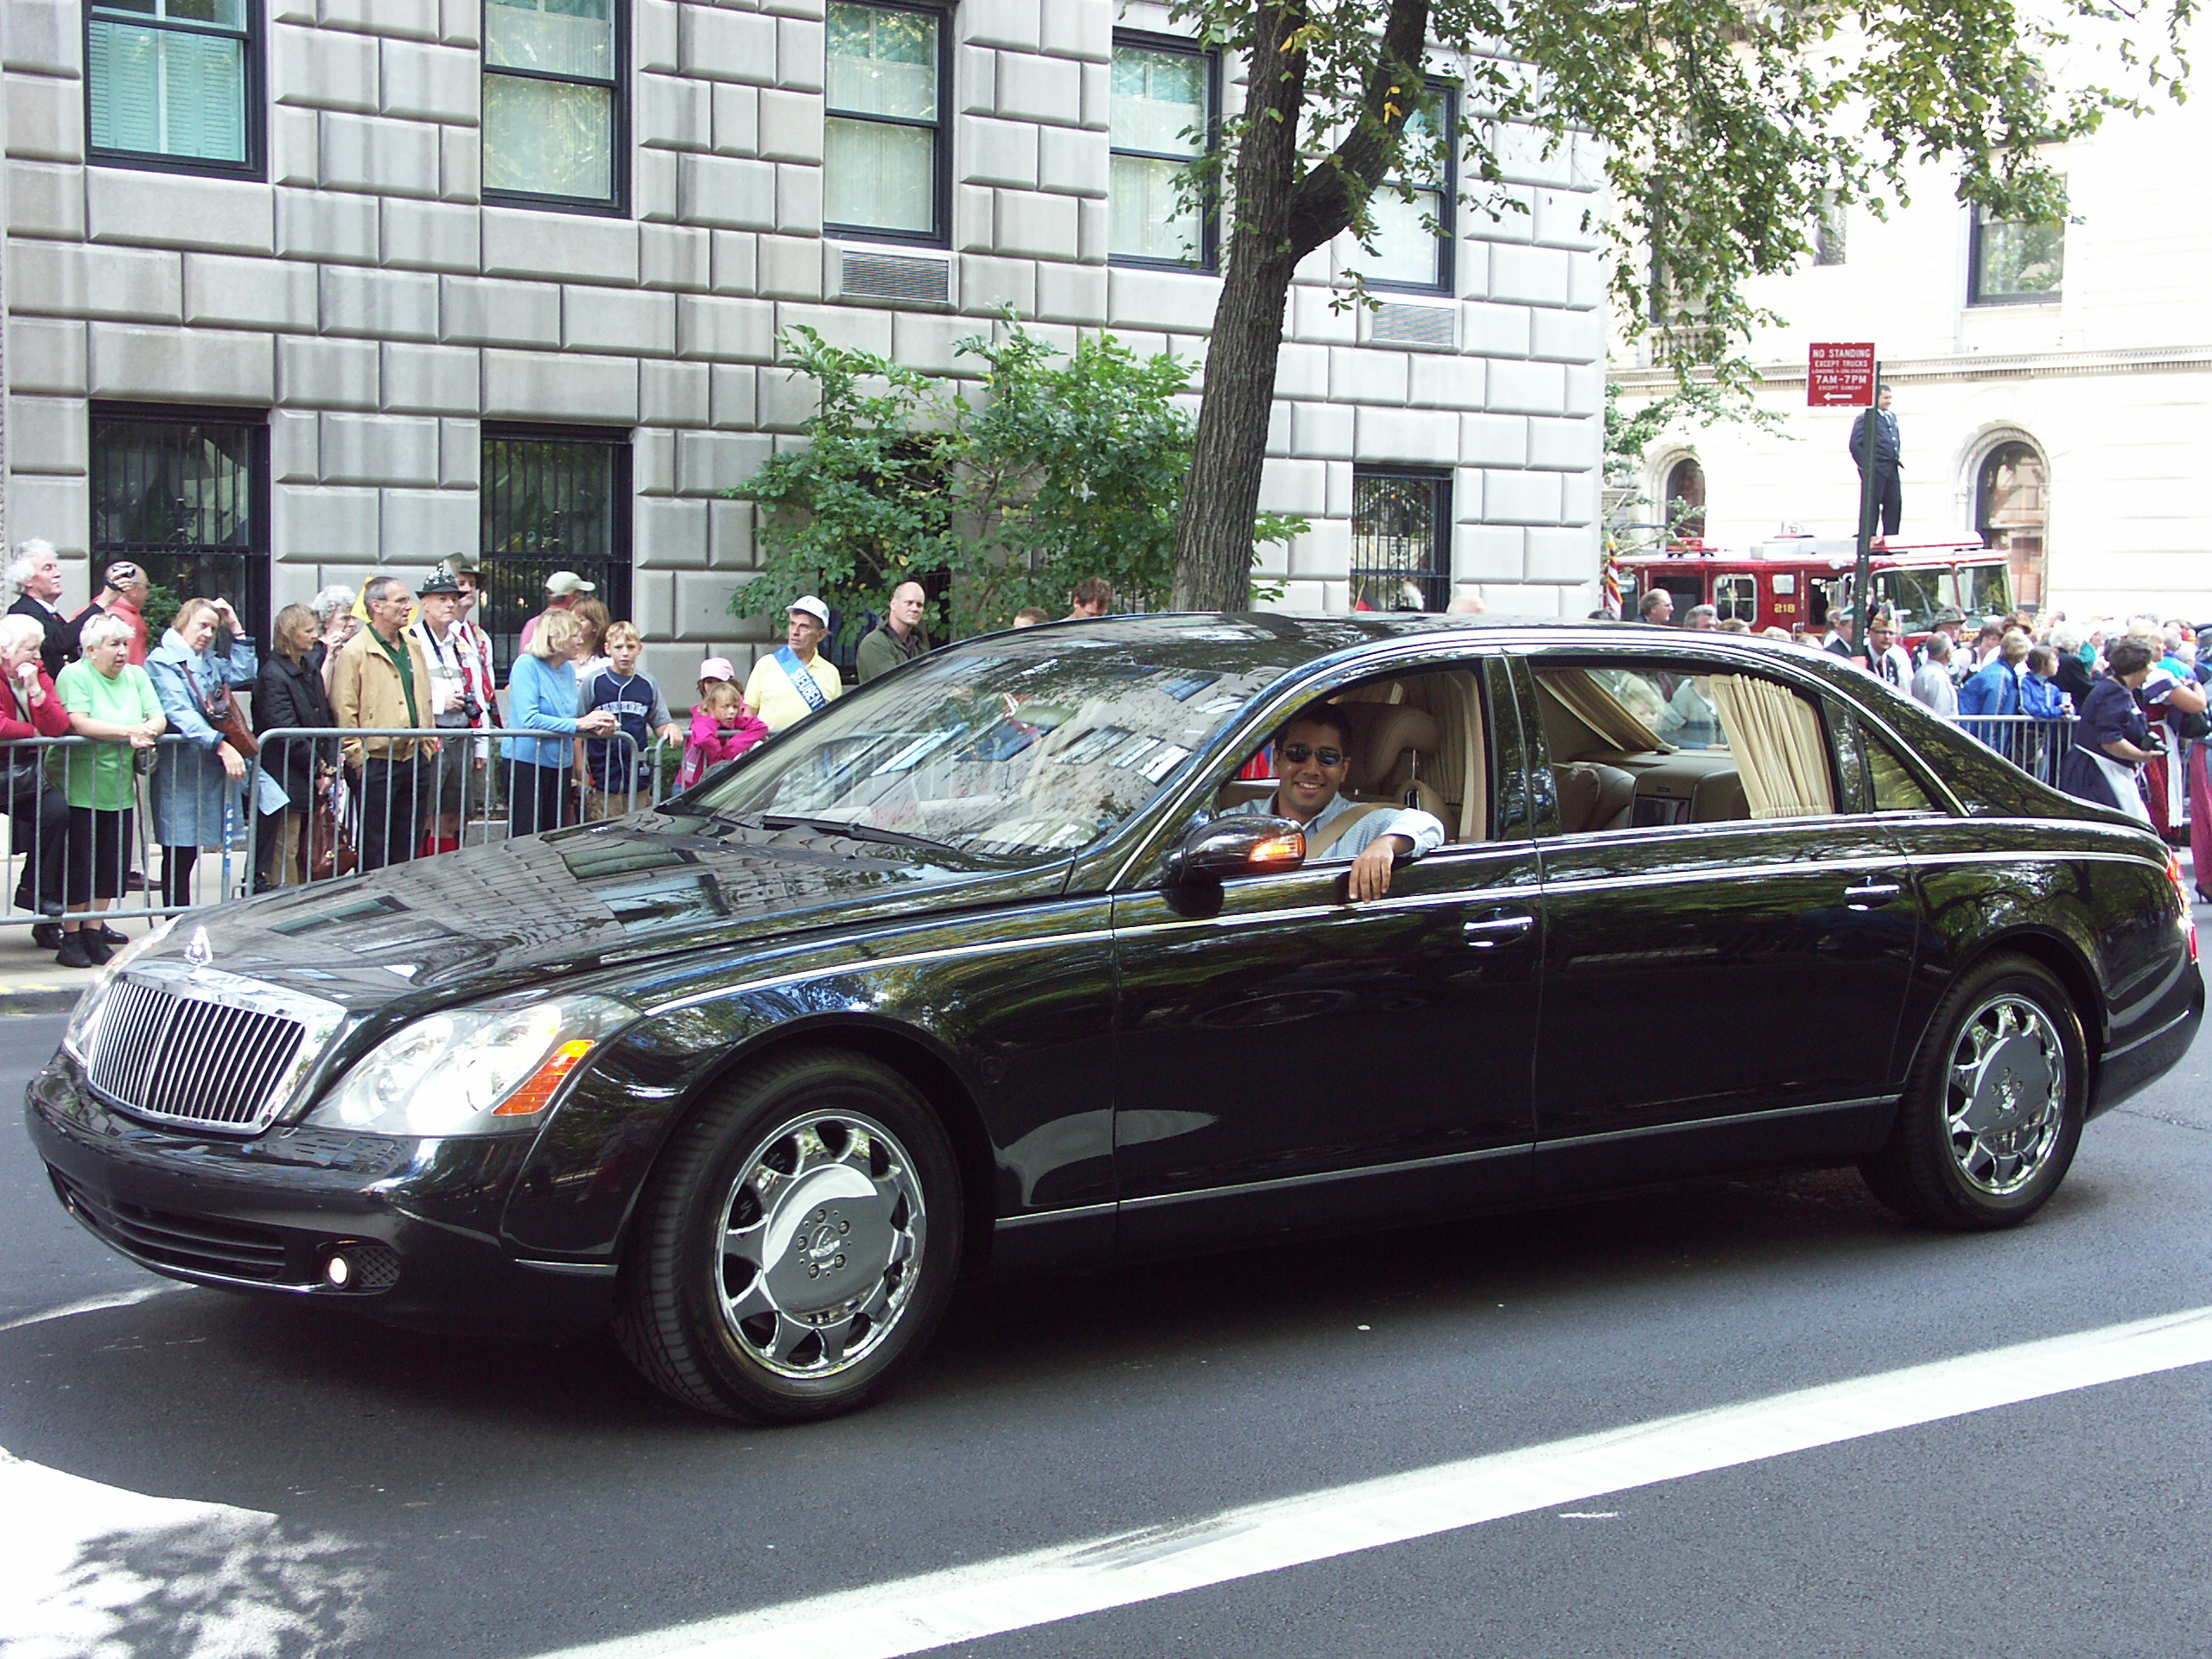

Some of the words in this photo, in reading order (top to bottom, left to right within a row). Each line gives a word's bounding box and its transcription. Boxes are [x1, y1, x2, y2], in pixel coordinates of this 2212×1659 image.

[1813, 349, 1825, 358] NO
[1828, 349, 1871, 358] STANDING
[1774, 603, 1796, 613] 218
[790, 668, 823, 708] STEUBEN
